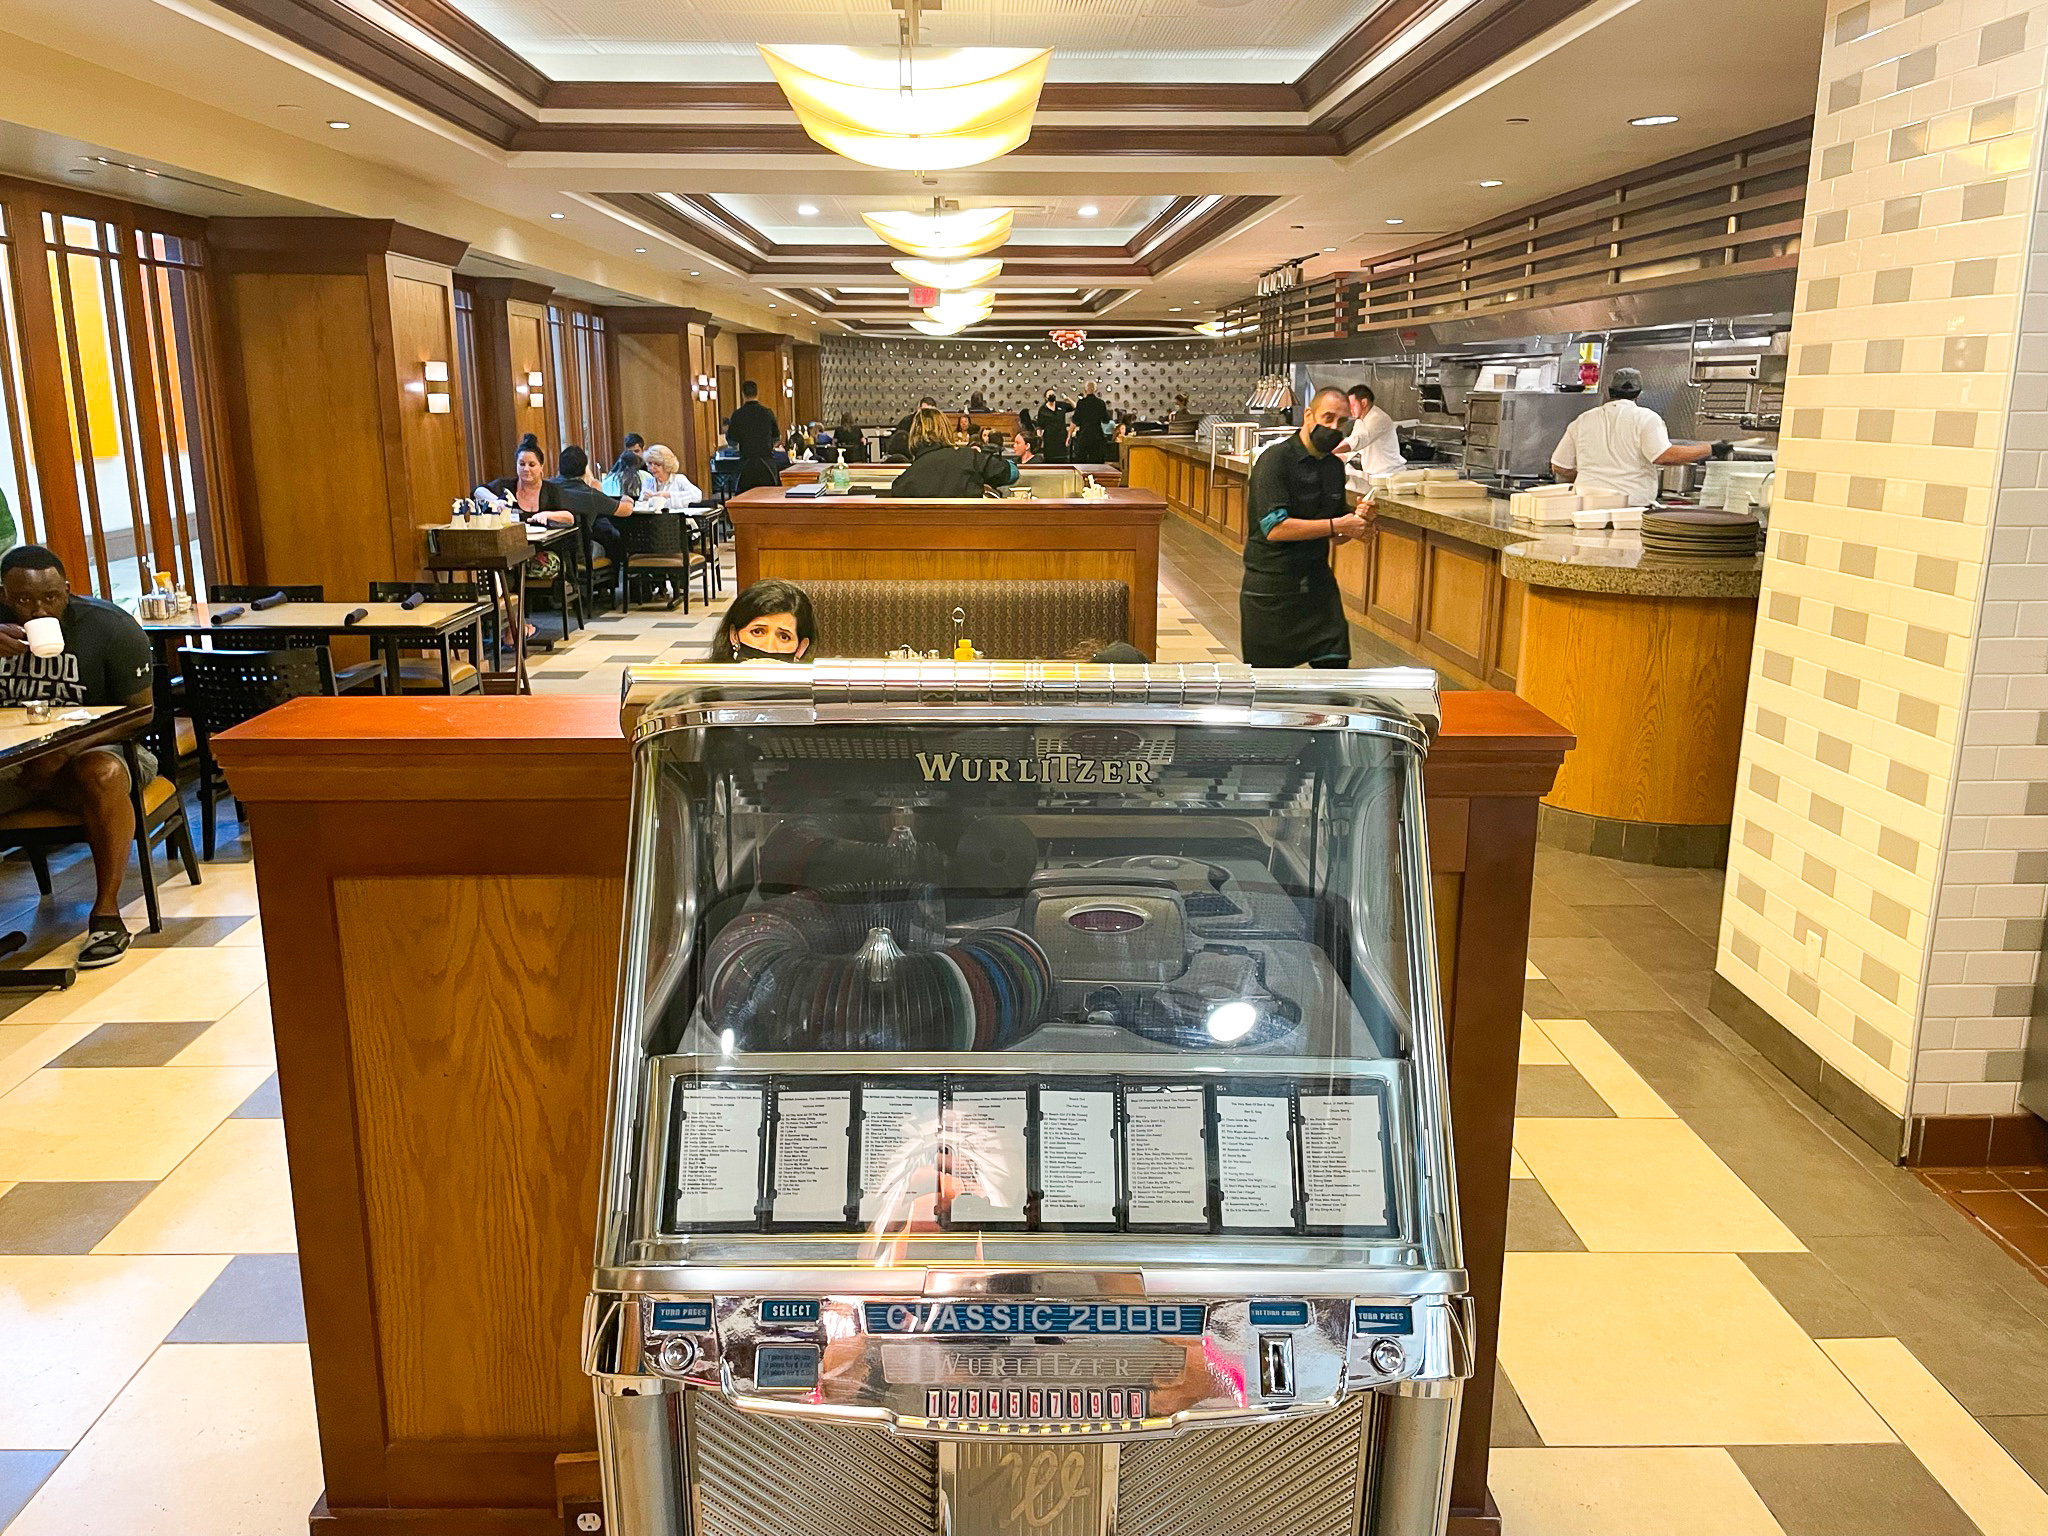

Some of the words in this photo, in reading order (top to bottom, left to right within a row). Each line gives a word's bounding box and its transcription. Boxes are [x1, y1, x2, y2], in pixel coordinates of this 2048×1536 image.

[0, 653, 80, 683] BLOOD
[915, 752, 1153, 783] WURLITZER
[773, 1305, 811, 1317] SELECT
[886, 1305, 1053, 1332] CLASSIC
[1068, 1305, 1181, 1332] 2000
[1359, 1312, 1378, 1320] TURN
[1380, 1312, 1404, 1320] PAGES
[940, 1352, 1130, 1376] WURLITZER
[931, 1393, 937, 1414] 1
[950, 1393, 958, 1414] 2
[970, 1393, 978, 1414] 3
[990, 1393, 999, 1414] 4
[1010, 1393, 1019, 1414] 5
[1031, 1393, 1040, 1414] 6
[1051, 1393, 1059, 1414] 7
[1072, 1393, 1080, 1414] 8
[1092, 1393, 1100, 1414] 9
[1113, 1393, 1121, 1414] 0
